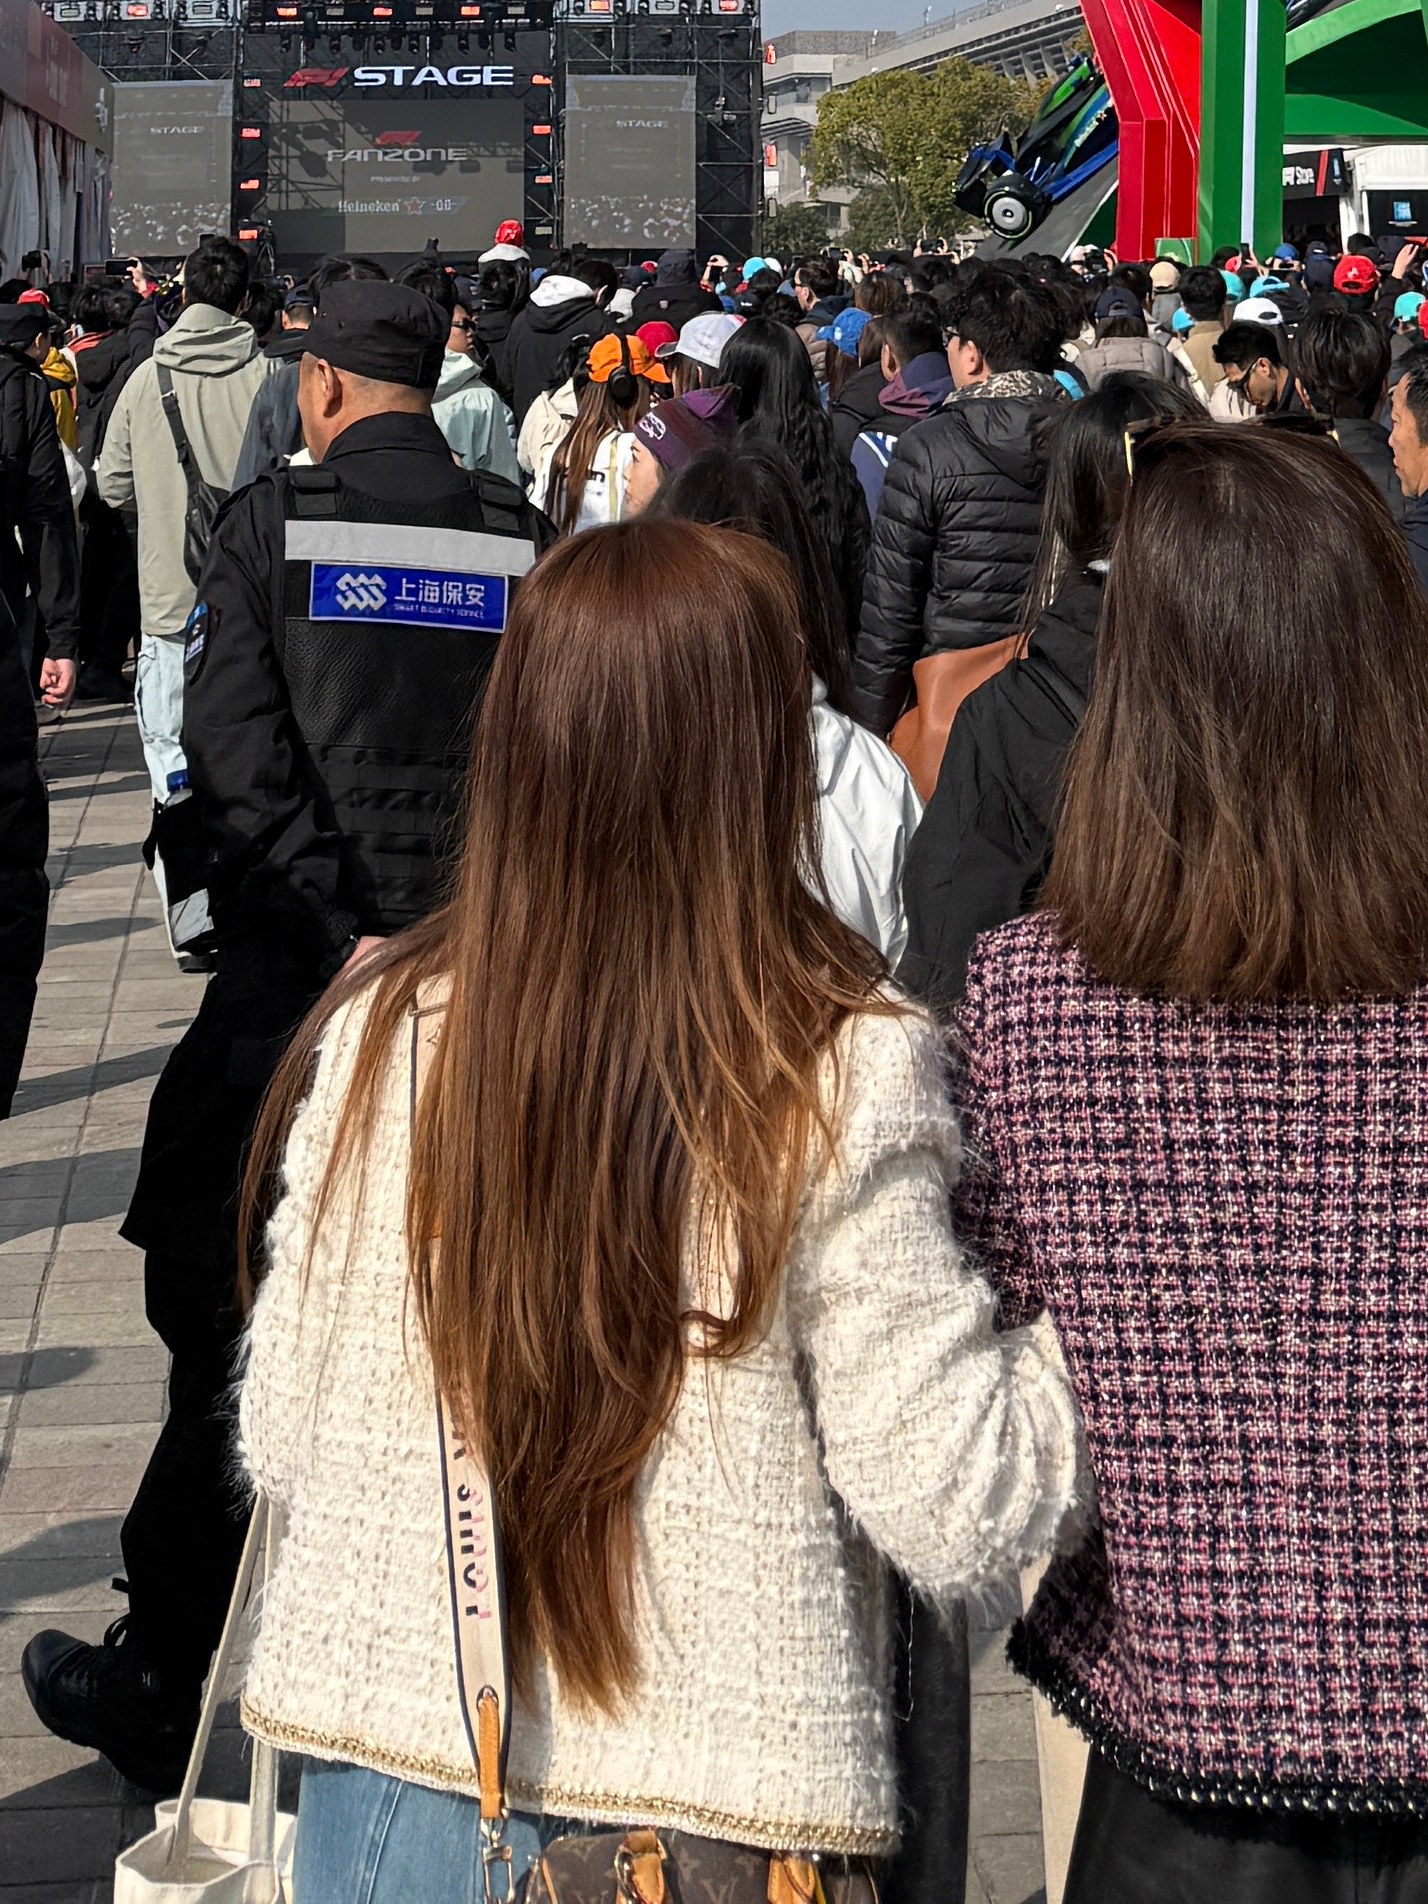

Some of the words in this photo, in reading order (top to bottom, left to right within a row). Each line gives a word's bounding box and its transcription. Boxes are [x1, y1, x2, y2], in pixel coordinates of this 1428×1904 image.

[354, 65, 514, 87] STAGE
[326, 147, 469, 162] FANZONE
[338, 199, 400, 213] Heineken
[394, 578, 485, 607] 上海保安
